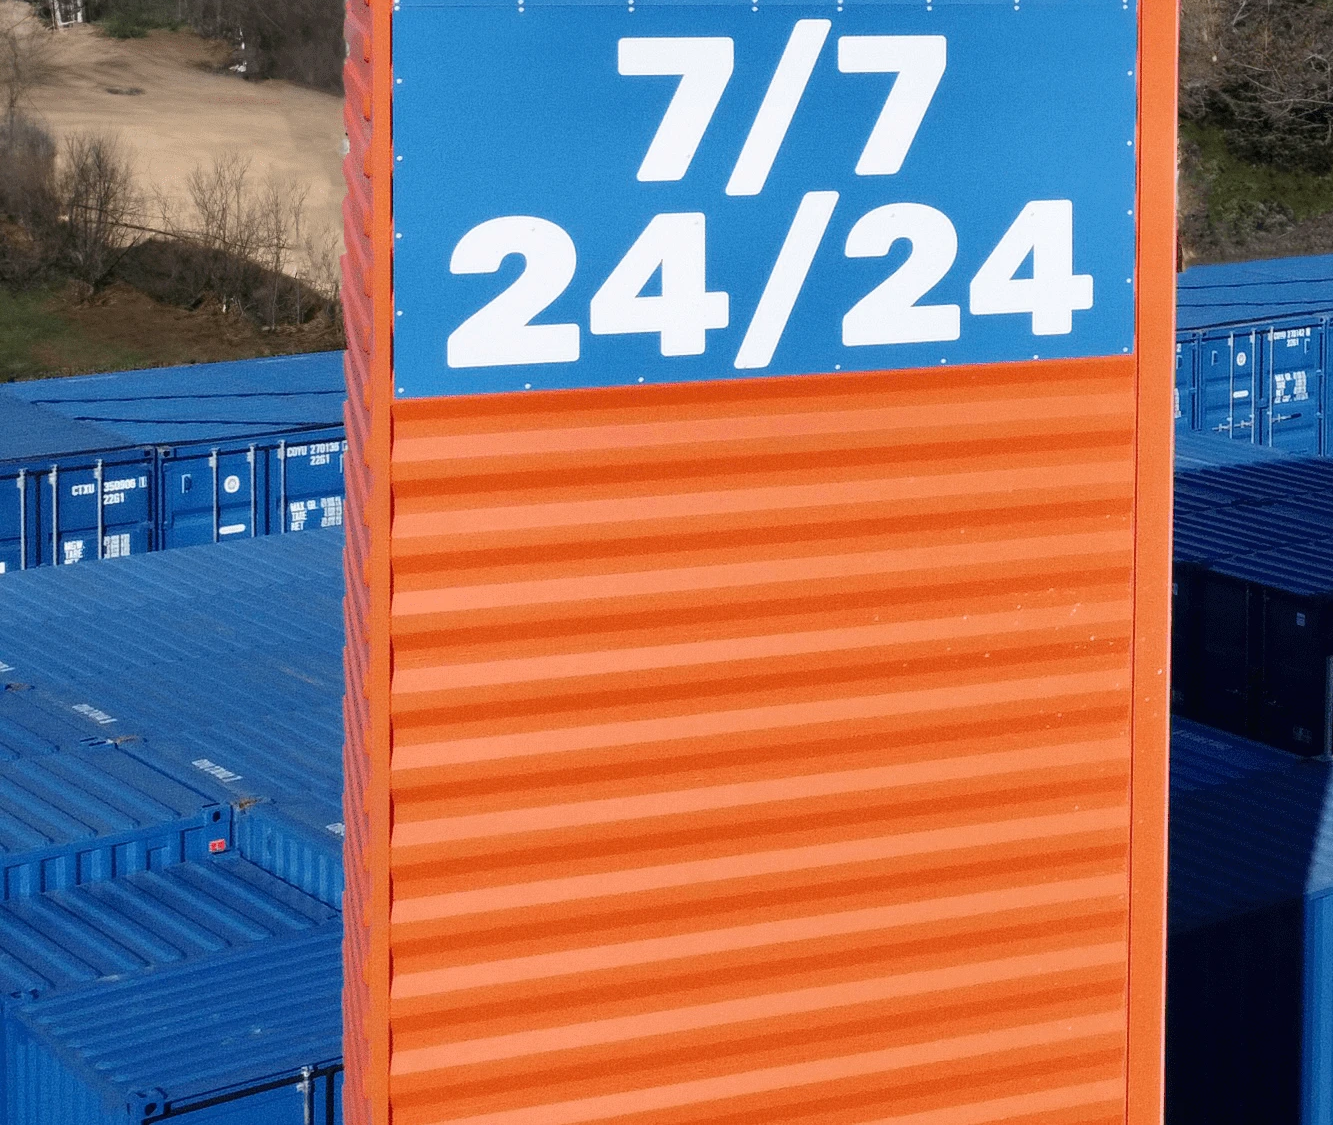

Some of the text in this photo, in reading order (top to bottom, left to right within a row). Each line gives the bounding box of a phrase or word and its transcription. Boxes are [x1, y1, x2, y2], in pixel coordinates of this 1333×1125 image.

[617, 18, 947, 196] 7/7
[446, 190, 1094, 370] 24/24
[71, 483, 95, 496] CTXU
